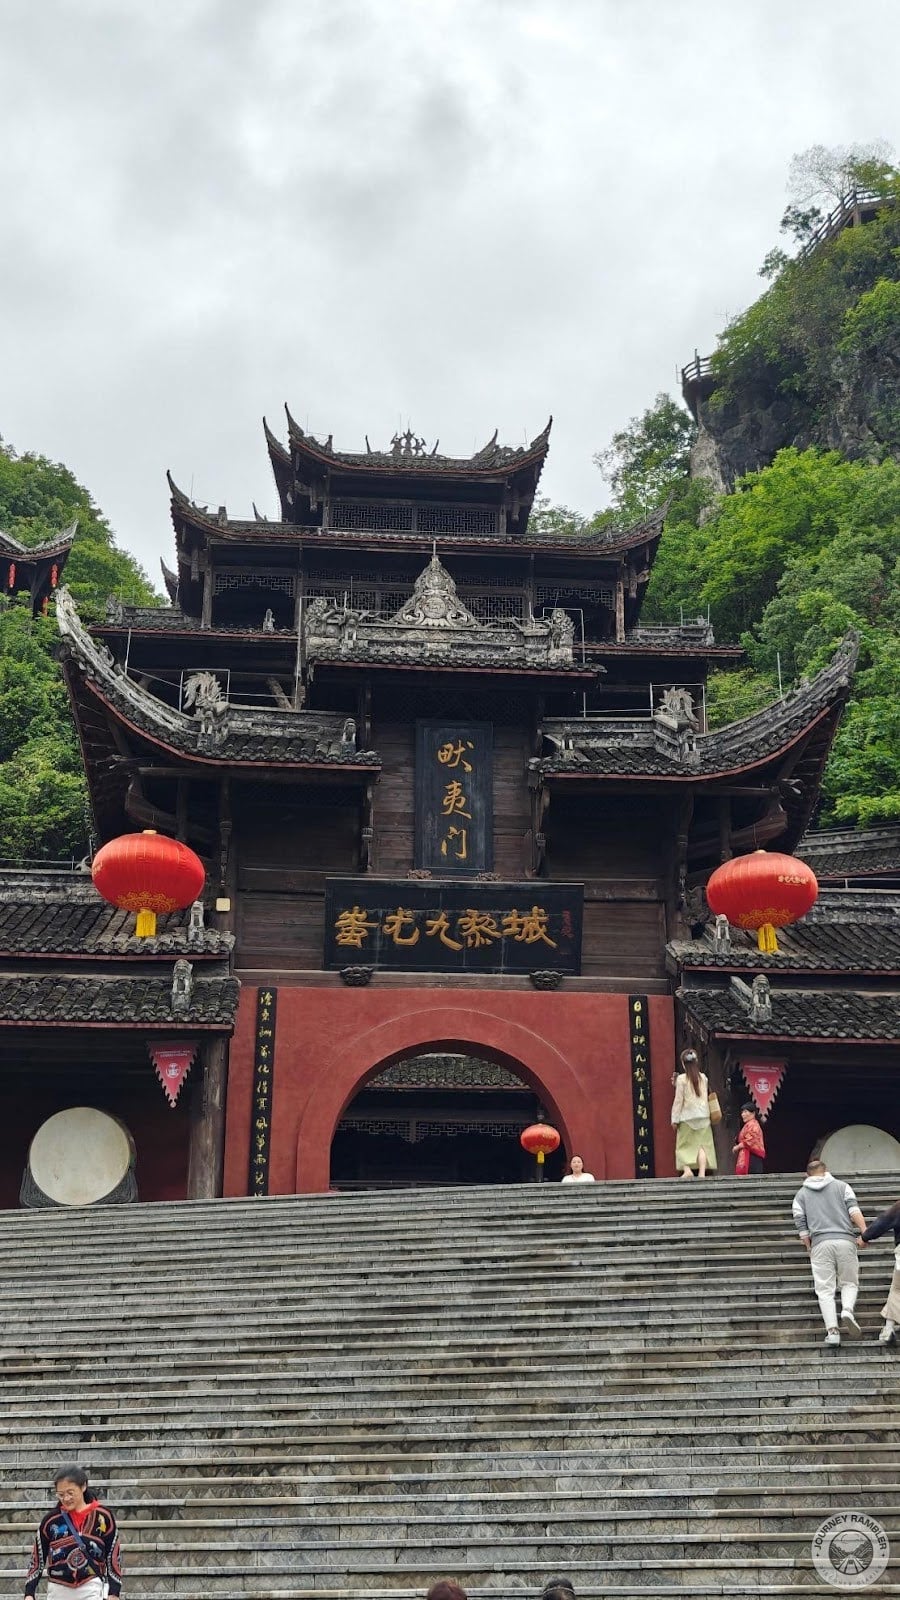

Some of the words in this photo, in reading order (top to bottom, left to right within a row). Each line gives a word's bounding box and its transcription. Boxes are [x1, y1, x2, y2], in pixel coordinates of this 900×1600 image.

[334, 905, 559, 951] 蚩尤九黎城
